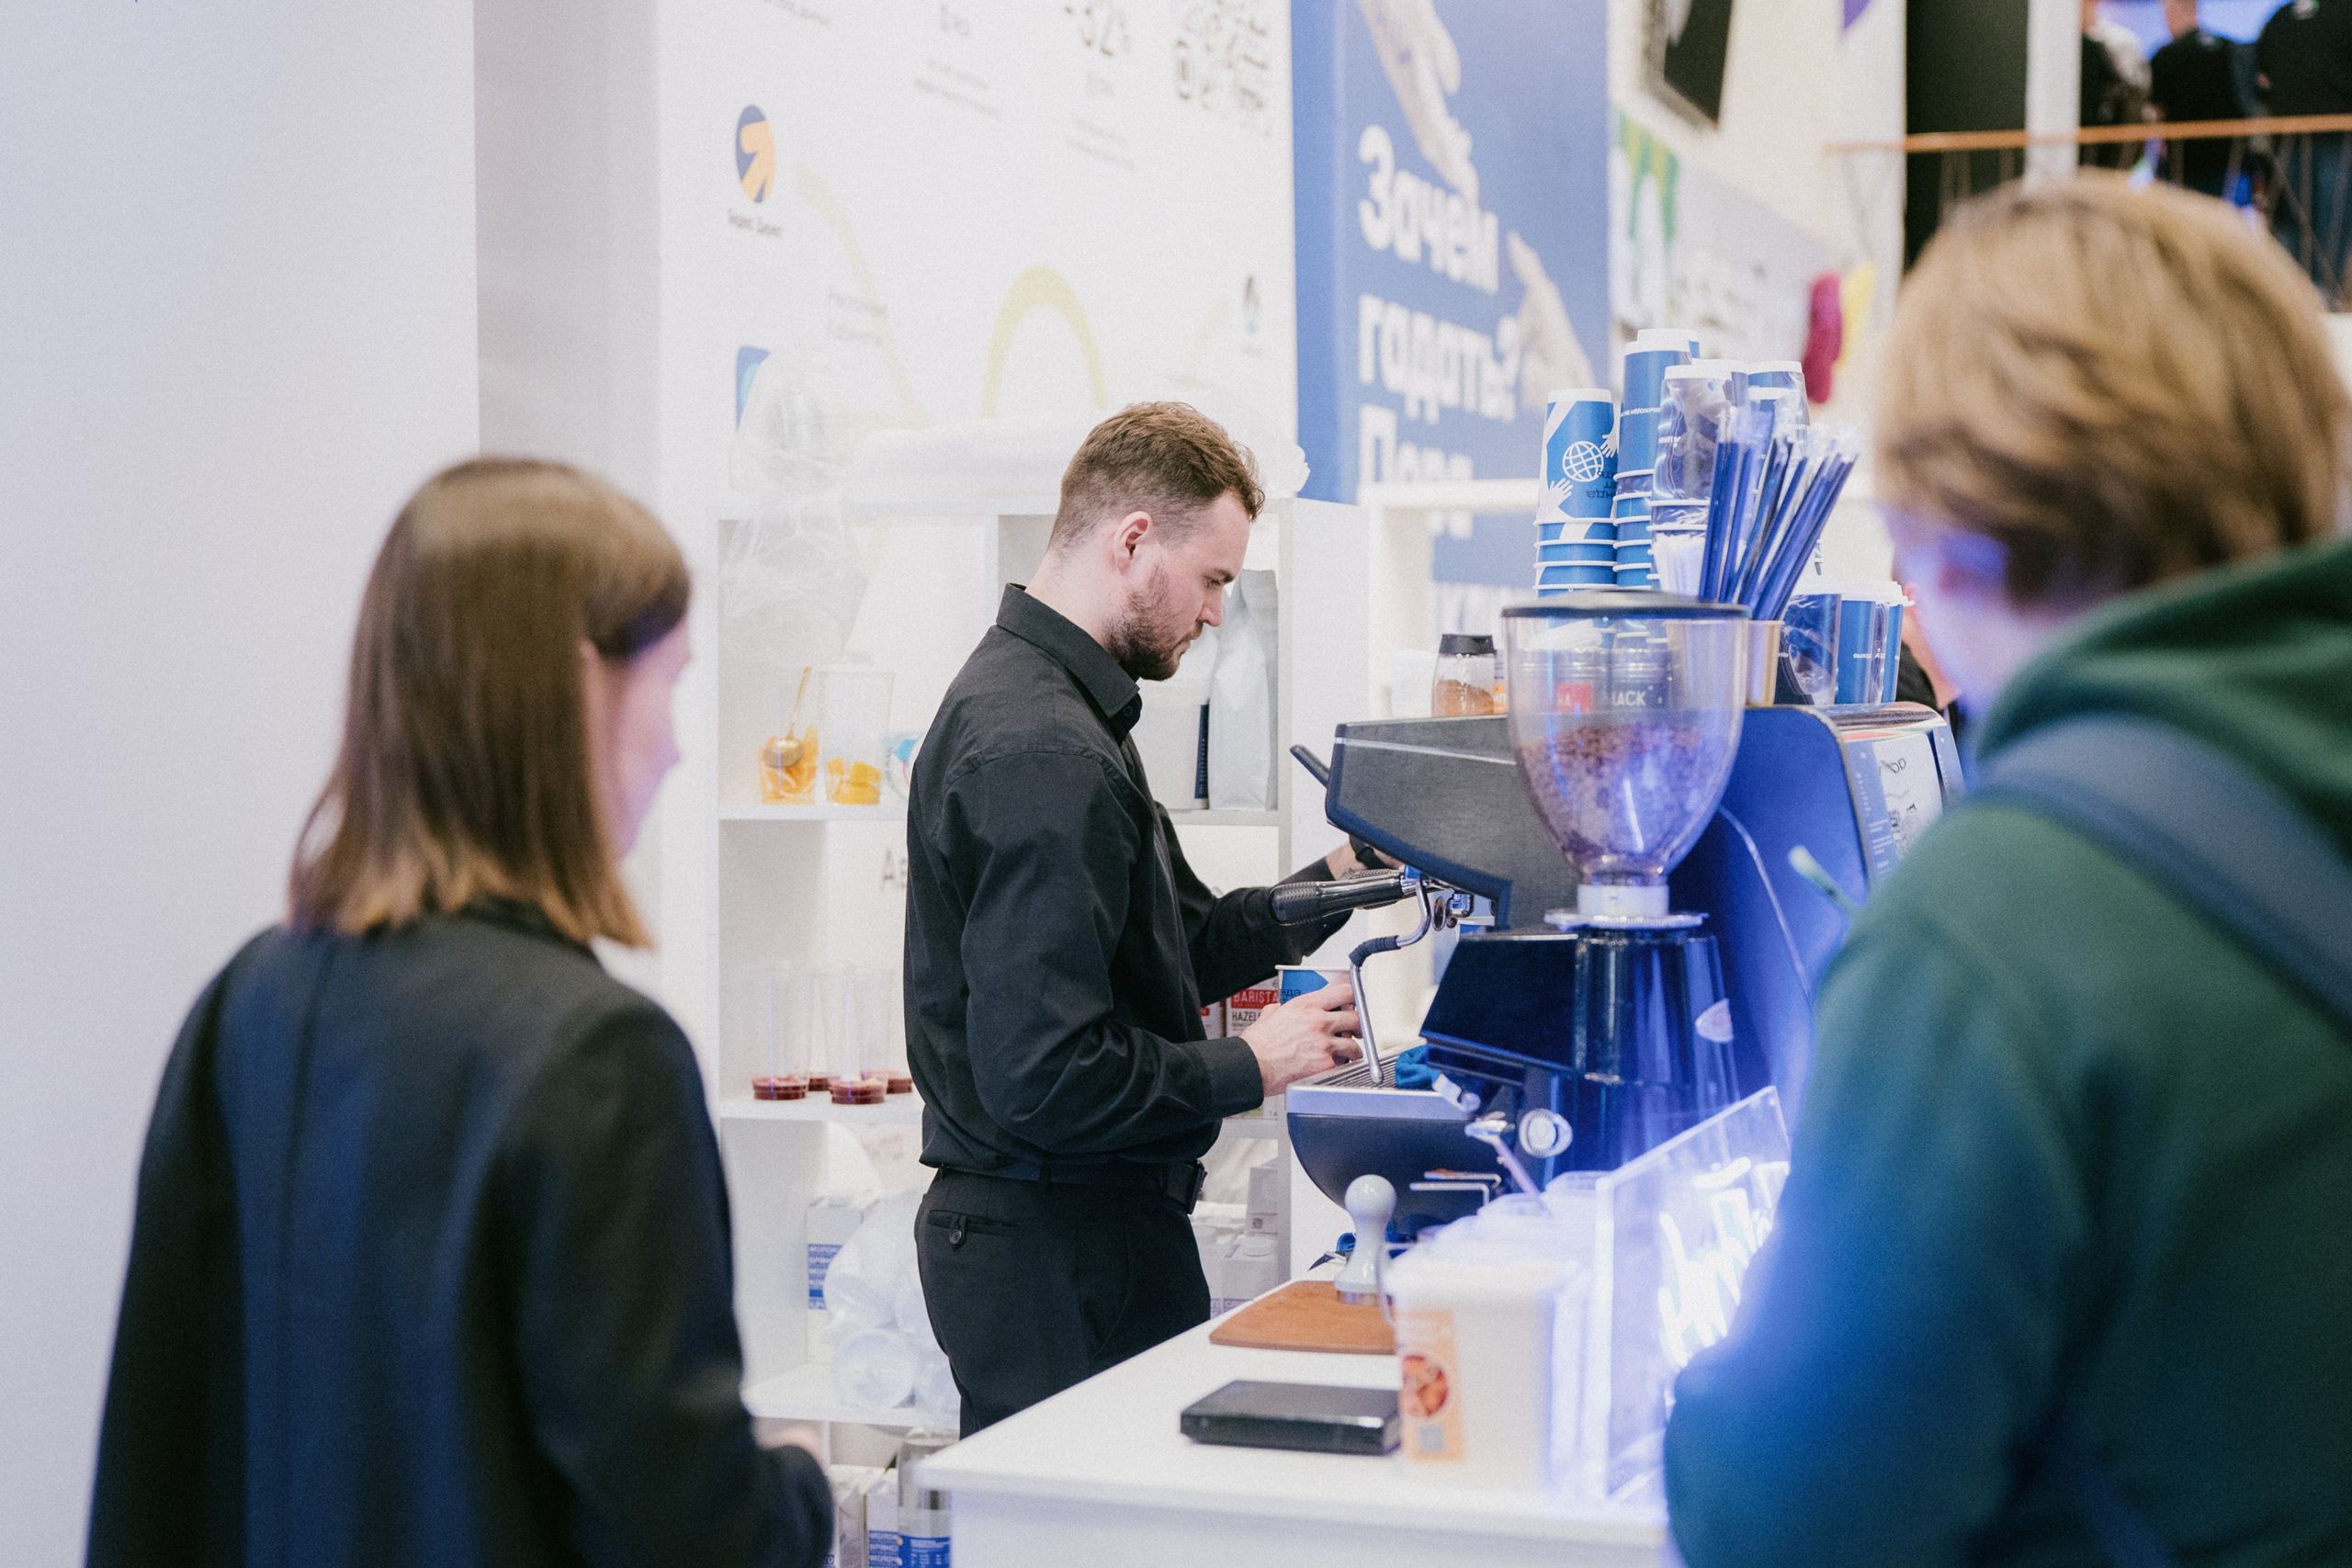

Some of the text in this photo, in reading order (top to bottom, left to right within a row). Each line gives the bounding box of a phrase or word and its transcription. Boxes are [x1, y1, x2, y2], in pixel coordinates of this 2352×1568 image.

[1358, 124, 1499, 295] Зачем
[1233, 990, 1280, 1003] BARISTA
[1232, 1010, 1261, 1021] HAZEL
